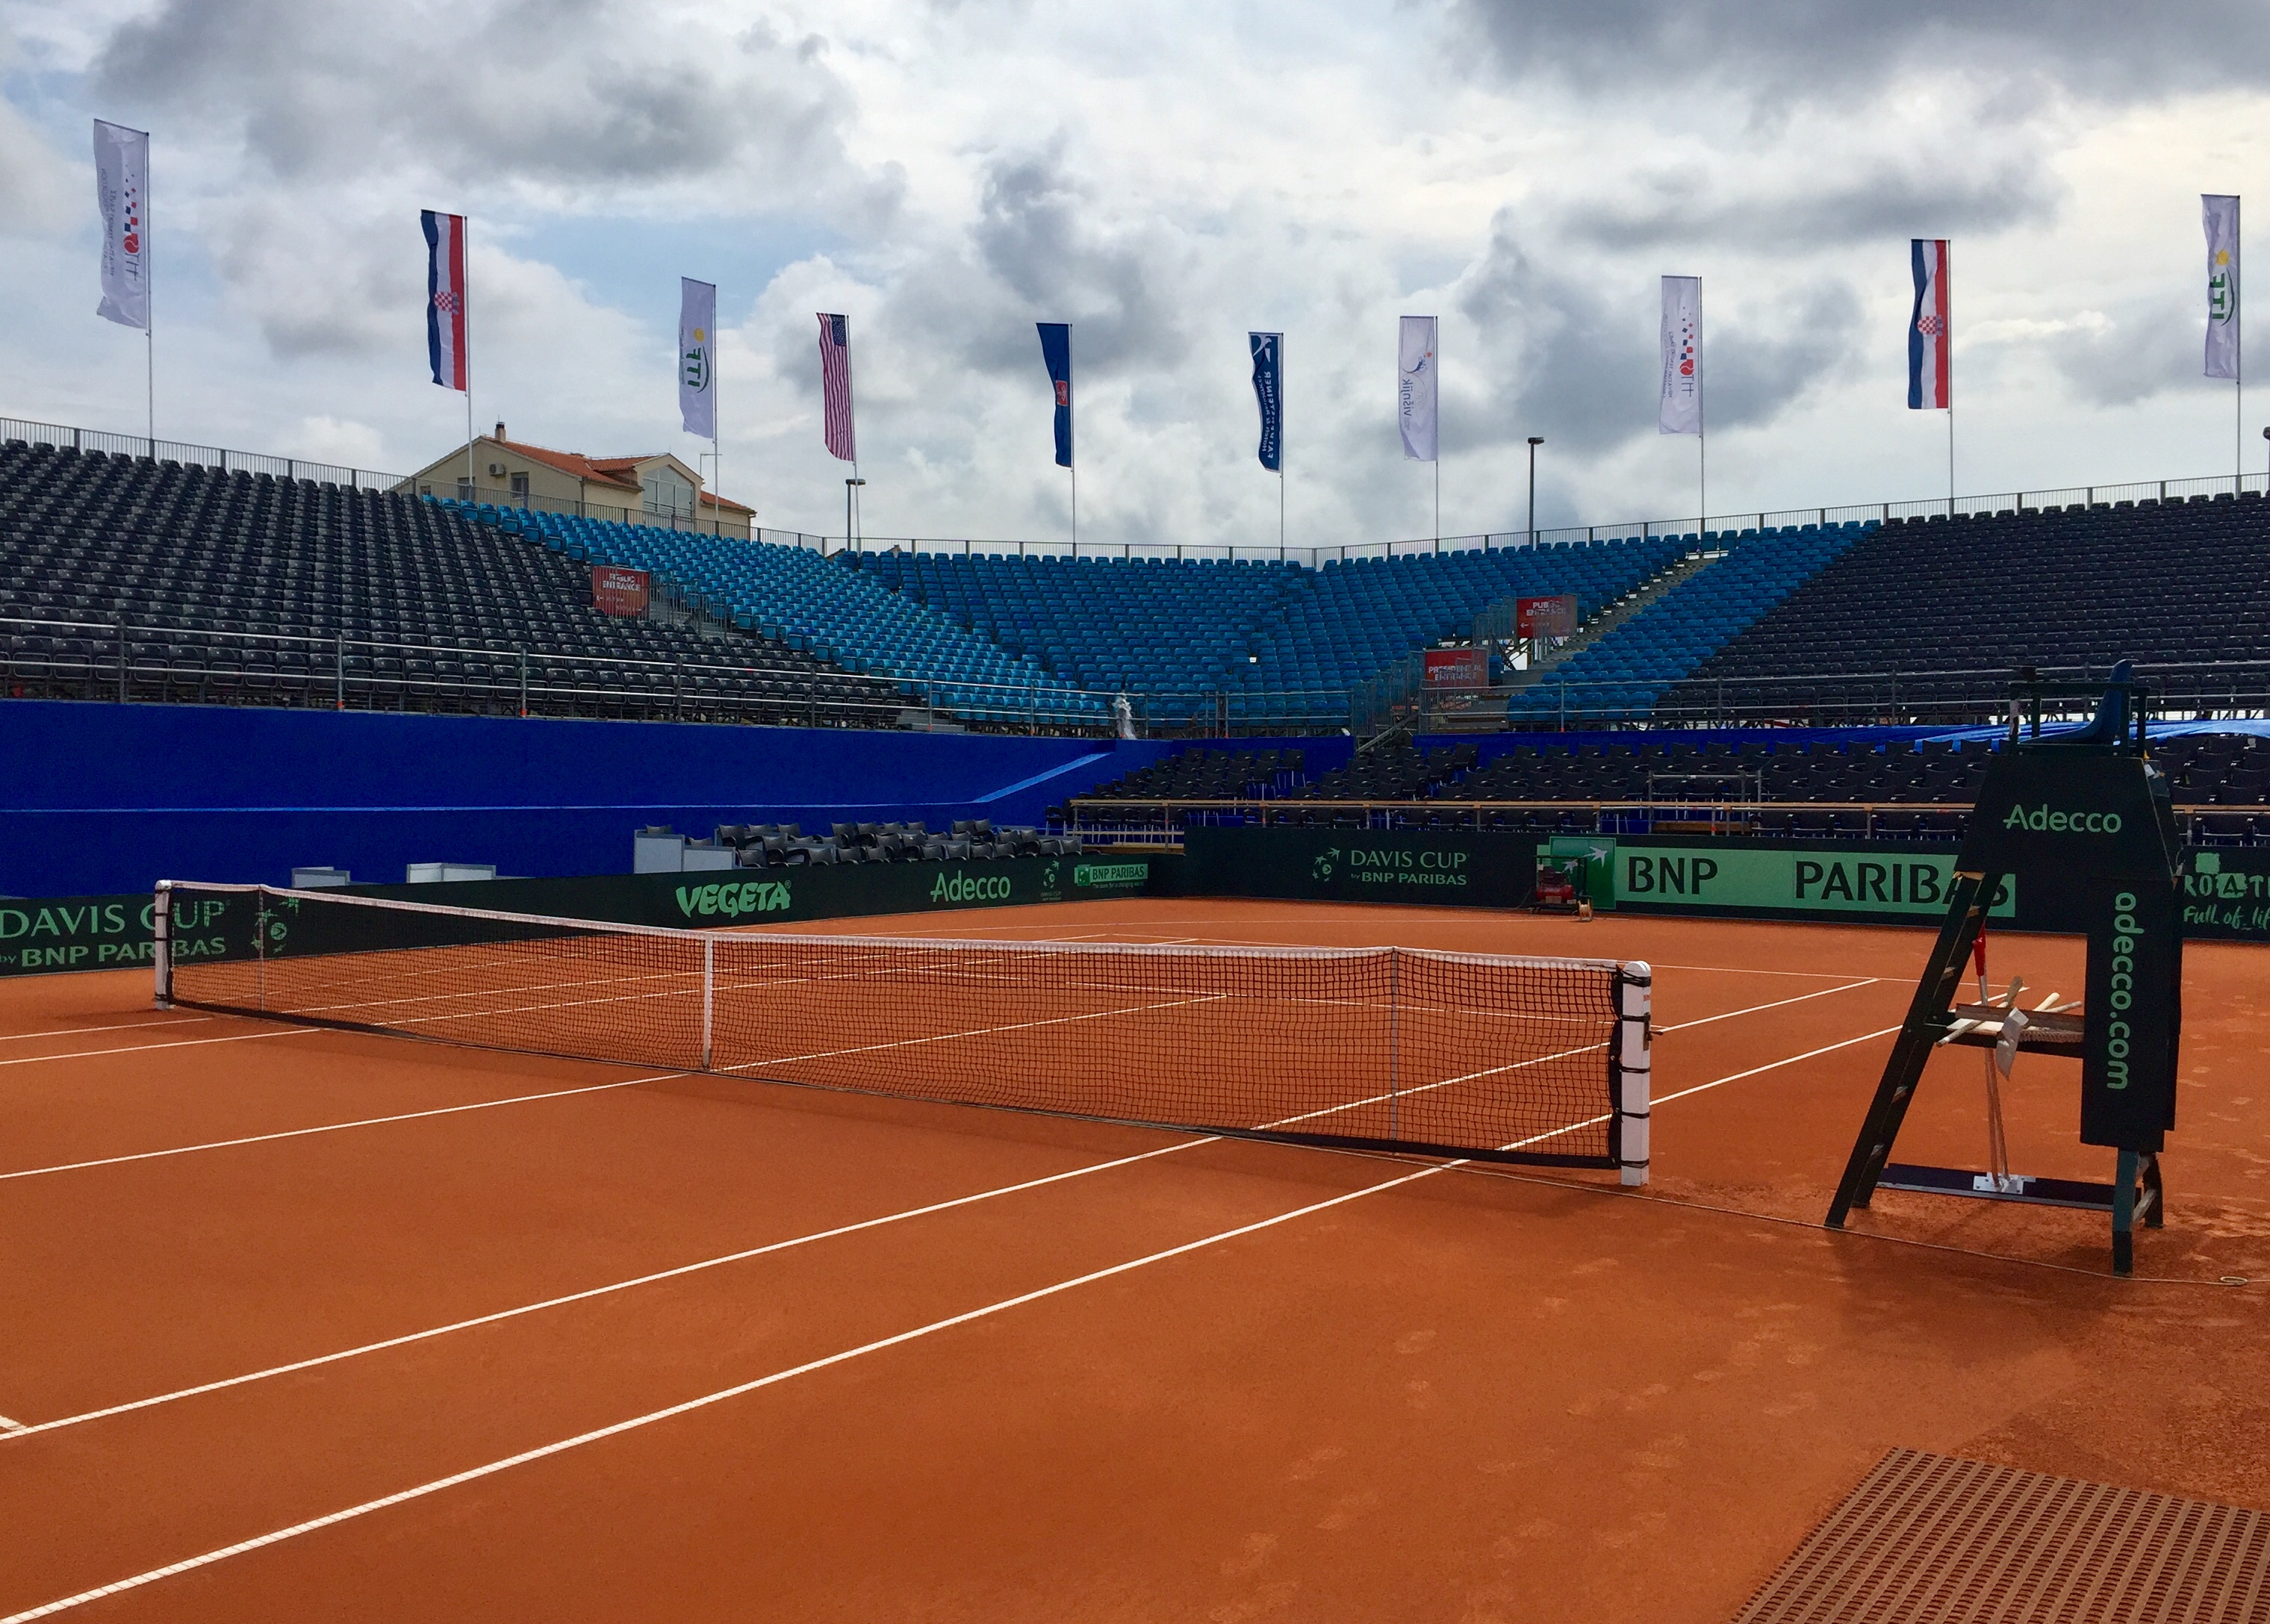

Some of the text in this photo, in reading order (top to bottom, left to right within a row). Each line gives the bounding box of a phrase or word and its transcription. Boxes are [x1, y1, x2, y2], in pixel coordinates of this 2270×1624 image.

[603, 580, 641, 591] ENTRANCE
[2003, 803, 2121, 833] Adecco
[1092, 866, 1144, 880] BNP PARIBAS
[1351, 850, 1413, 868] DAVIS
[930, 869, 1011, 903] Adecco
[1362, 871, 1394, 883] BNP
[1399, 873, 1467, 886] PARIBAS
[1627, 856, 1718, 895] BNP
[0, 904, 125, 939] DAVIS
[22, 945, 90, 967] BNP
[98, 936, 227, 962] PARBAS
[2106, 892, 2145, 1090] adecco.com
